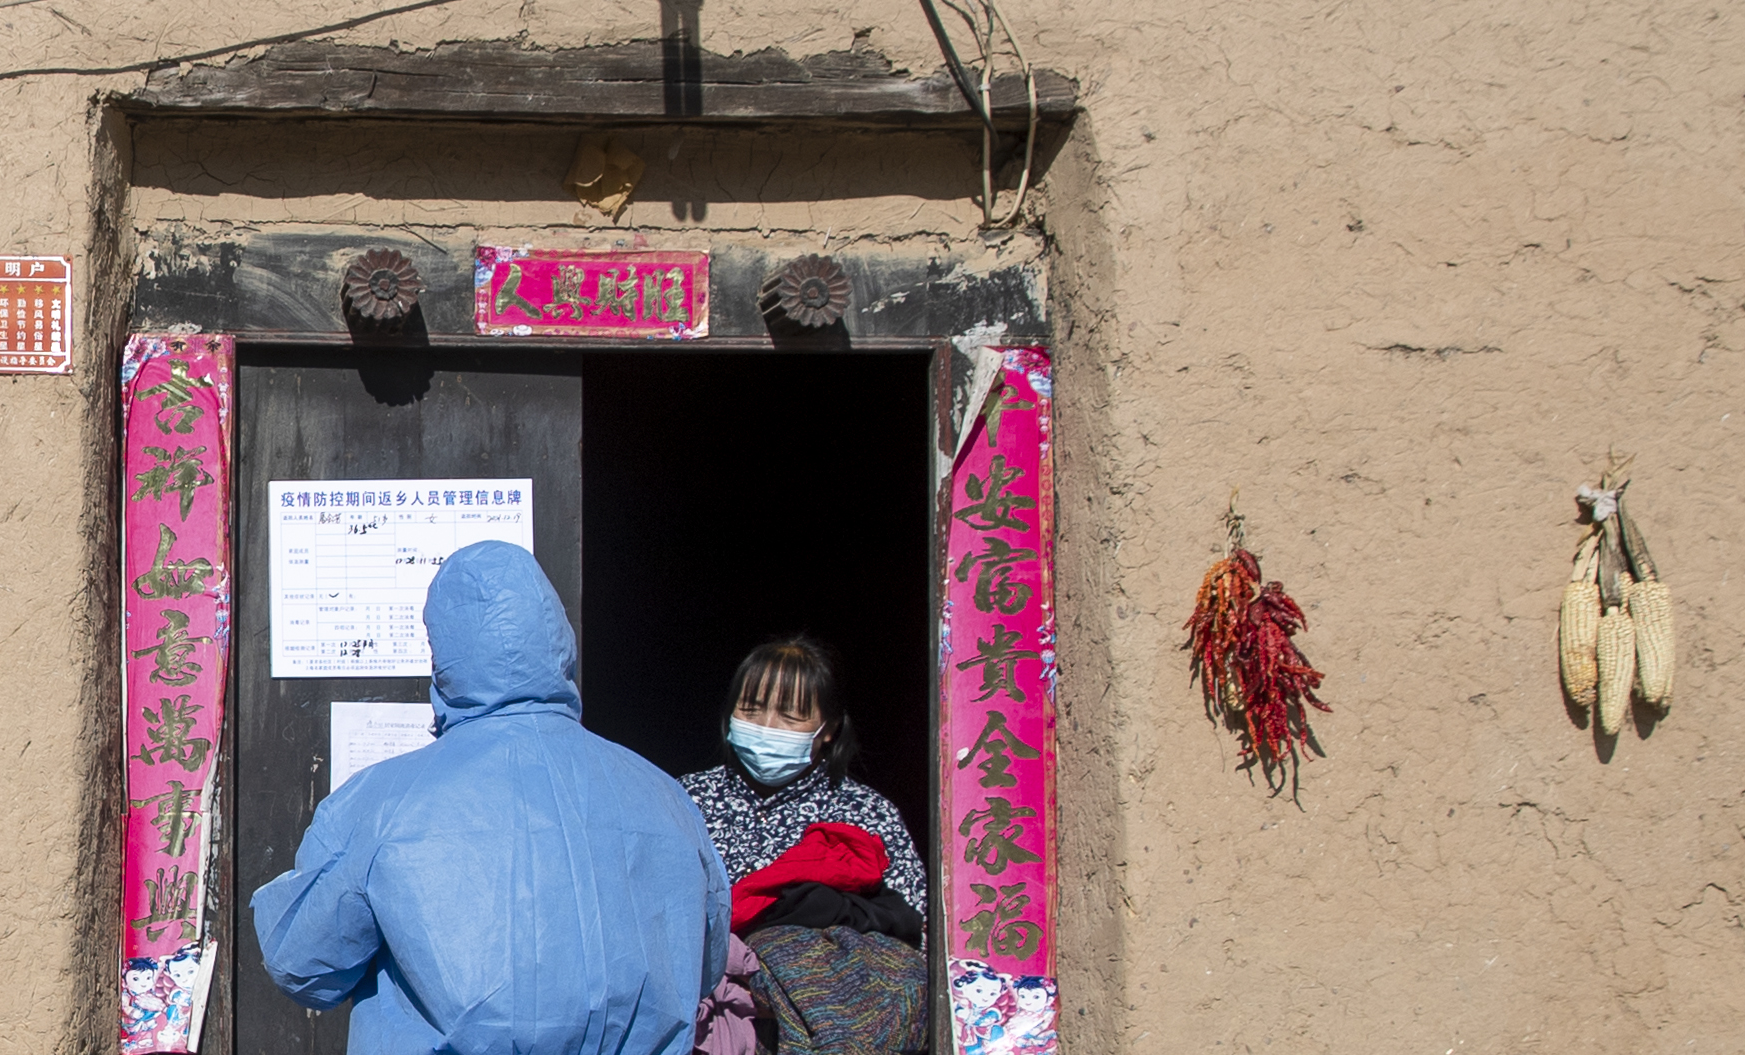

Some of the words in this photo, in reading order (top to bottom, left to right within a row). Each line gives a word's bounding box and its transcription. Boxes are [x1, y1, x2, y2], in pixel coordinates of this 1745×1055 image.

[16, 298, 27, 351] 勤俭节约星
[33, 298, 44, 351] 移风易俗星
[281, 490, 523, 508] 疫情防控期间返乡人员管理信息牌
[956, 371, 1043, 959] 平安富貴全家福
